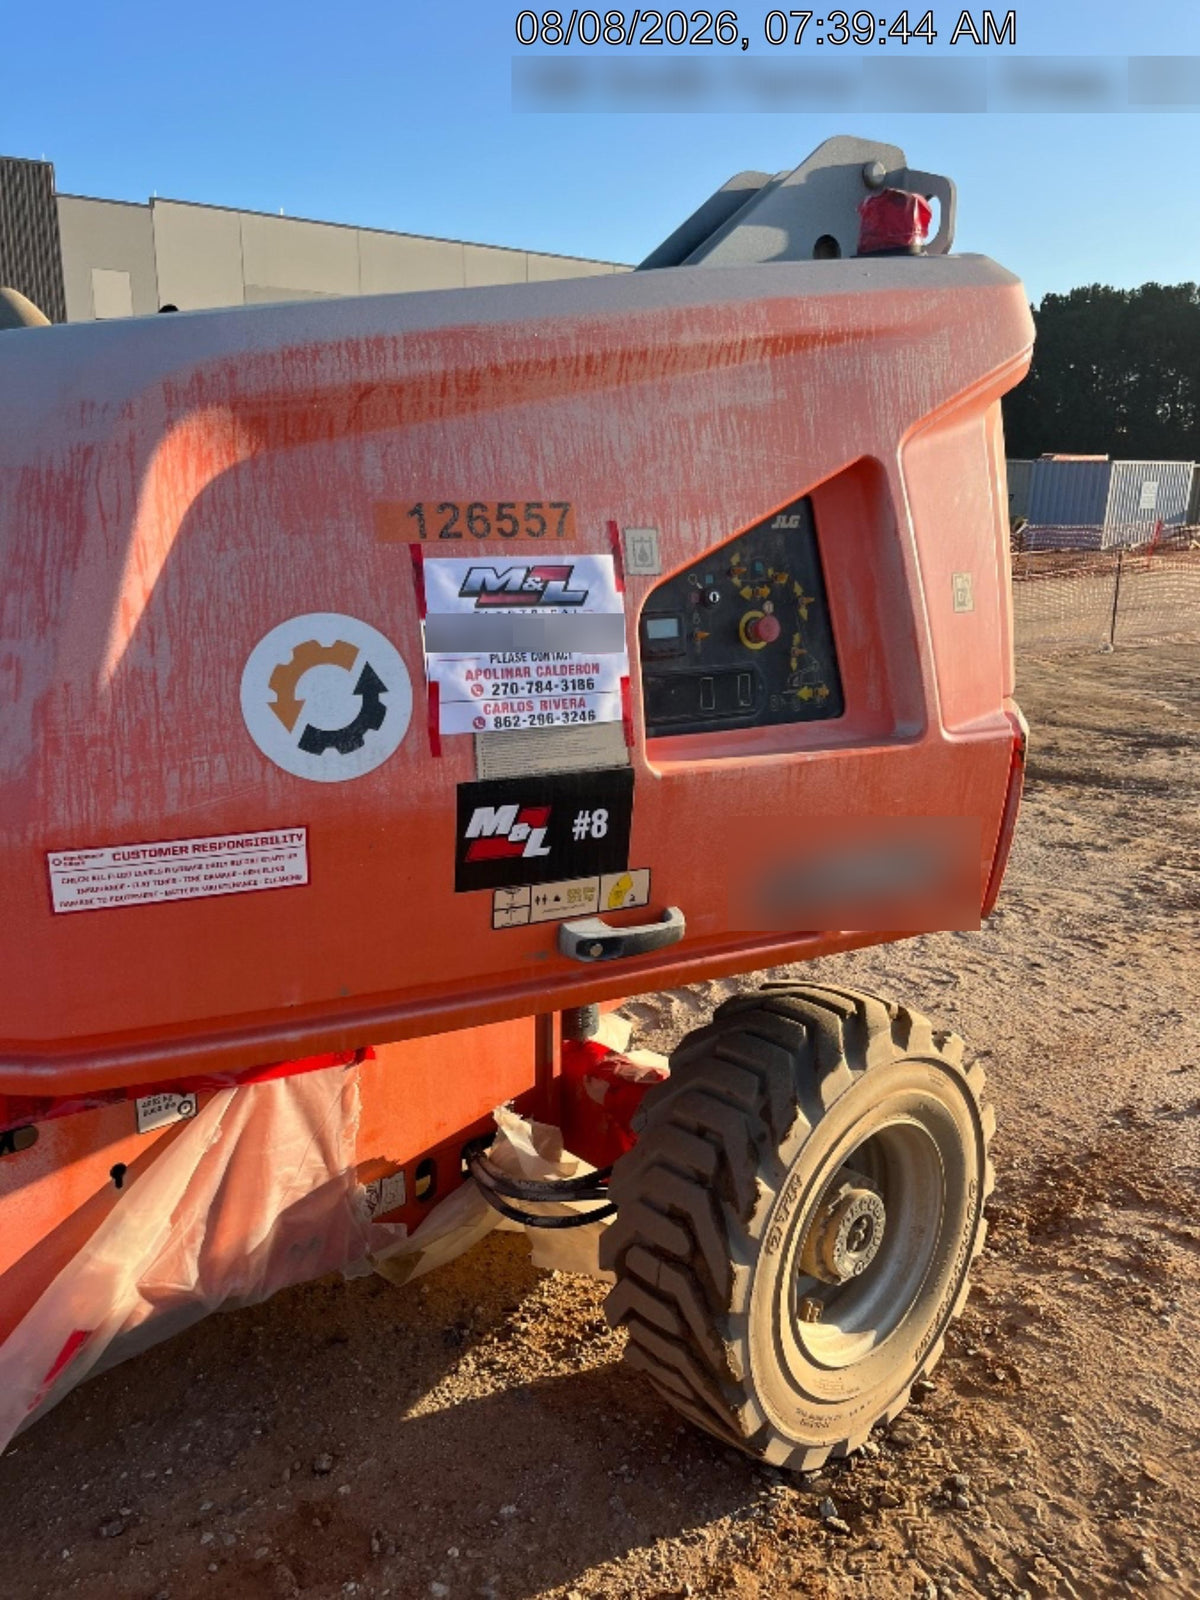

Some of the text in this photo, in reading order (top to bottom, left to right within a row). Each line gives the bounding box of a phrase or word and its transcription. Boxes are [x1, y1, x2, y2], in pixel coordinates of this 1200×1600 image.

[407, 502, 572, 539] 126557
[771, 514, 801, 529] JLG
[459, 565, 589, 608] M&L
[490, 652, 527, 664] PLEASE
[465, 662, 600, 681] APOLINAR CALDERON
[483, 697, 587, 715] CARLOS RIVERA
[464, 803, 609, 858] M&L #8
[112, 845, 189, 861] CUSTOMER
[192, 833, 303, 854] RESPONSIBILITY
